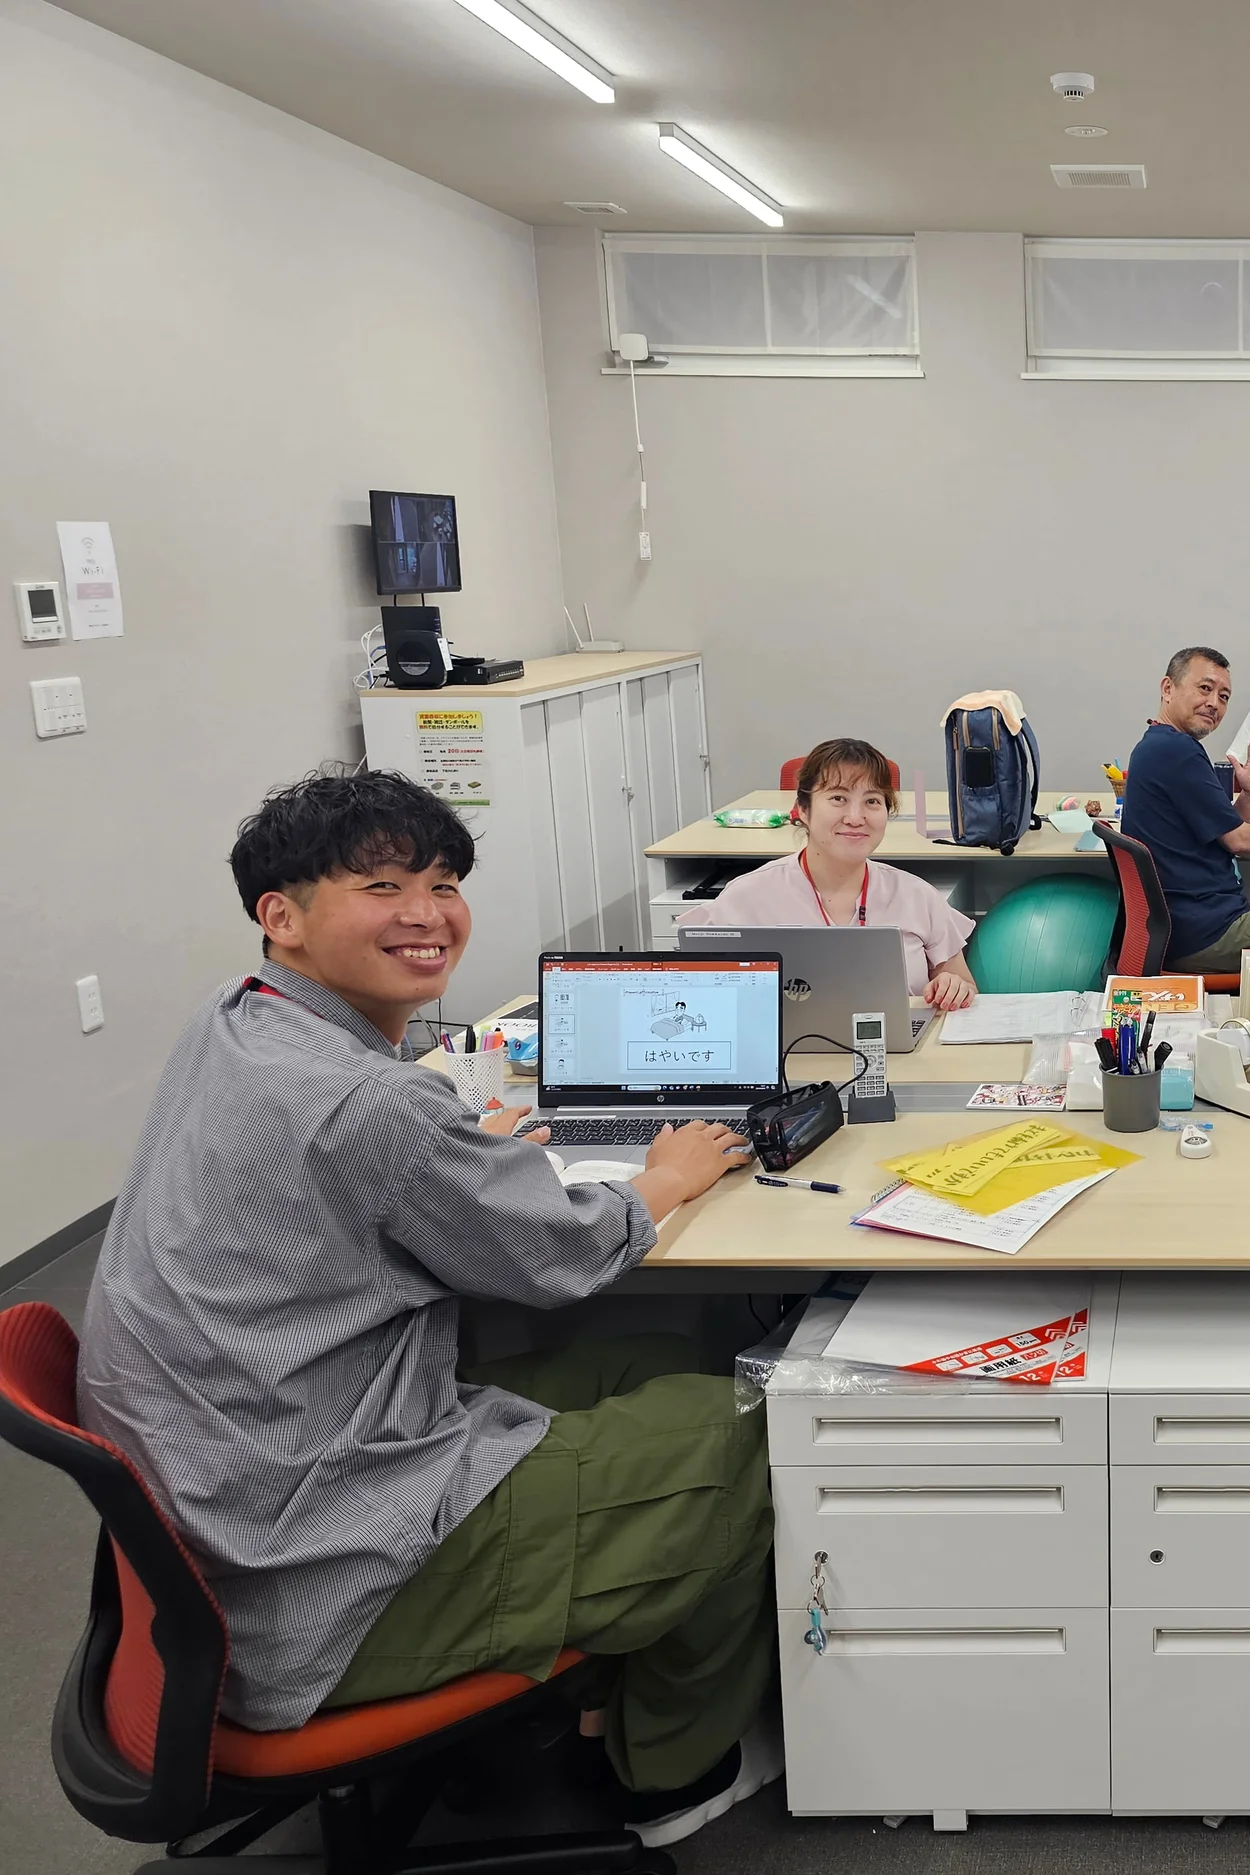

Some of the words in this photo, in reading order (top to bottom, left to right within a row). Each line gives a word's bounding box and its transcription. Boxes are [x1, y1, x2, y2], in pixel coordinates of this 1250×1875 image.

[82, 566, 104, 575] Wi-Fi
[784, 979, 811, 1001] hp
[645, 1049, 715, 1062] はやいです
[979, 1357, 1022, 1373] 画用紙
[1019, 1373, 1041, 1382] 12
